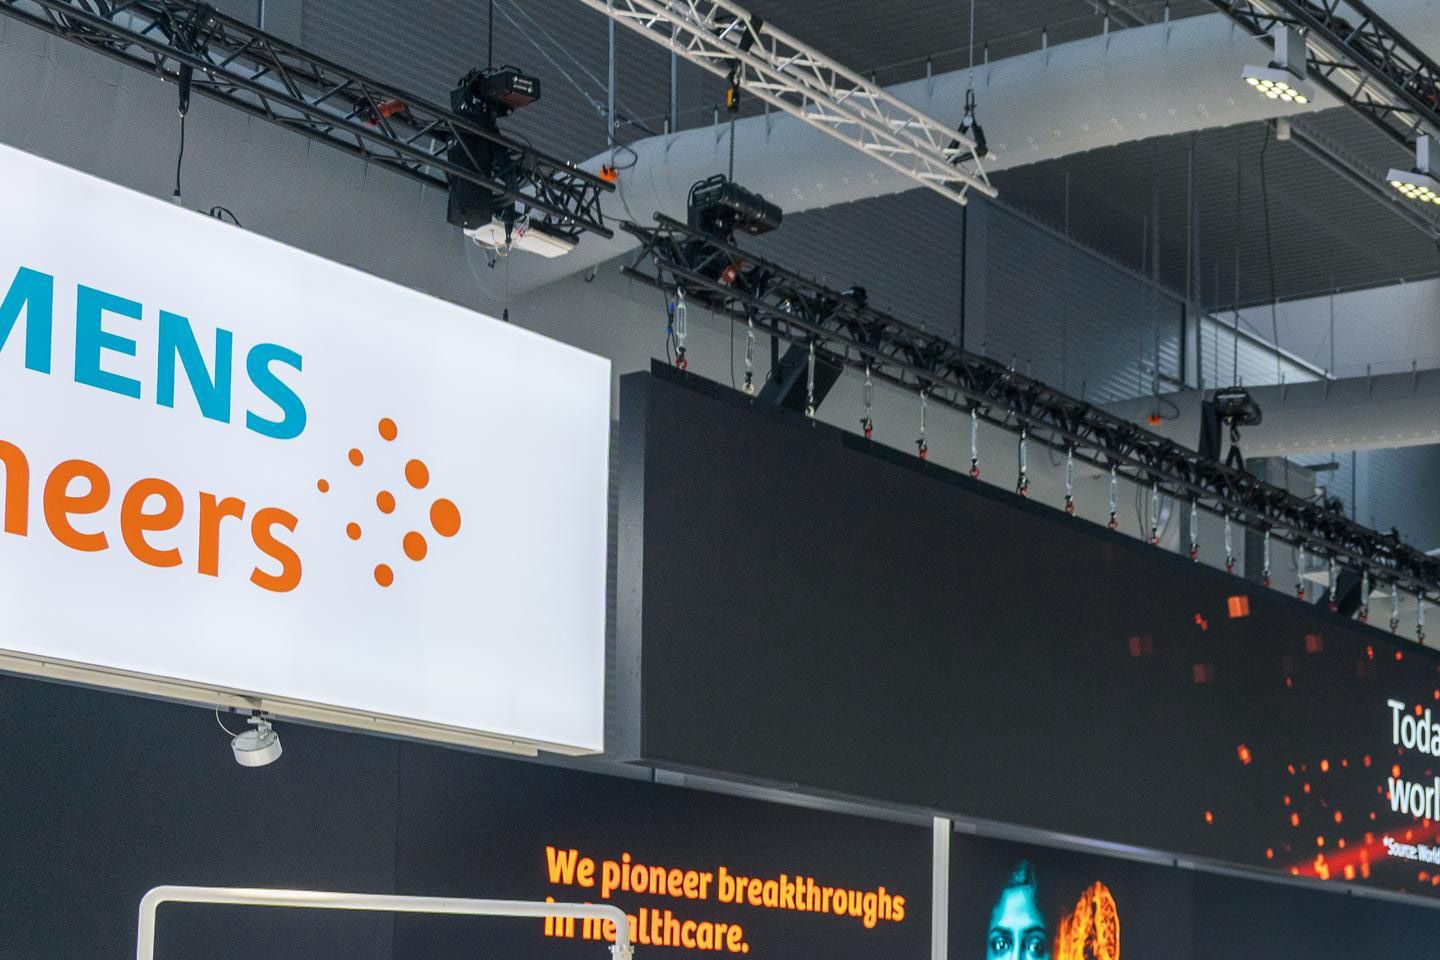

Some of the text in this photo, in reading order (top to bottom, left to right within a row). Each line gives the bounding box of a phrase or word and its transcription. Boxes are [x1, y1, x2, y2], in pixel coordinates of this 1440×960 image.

[1417, 844, 1440, 865] World
[546, 846, 905, 929] We pioneer breakthroughs
[544, 896, 749, 953] in healthcare.
